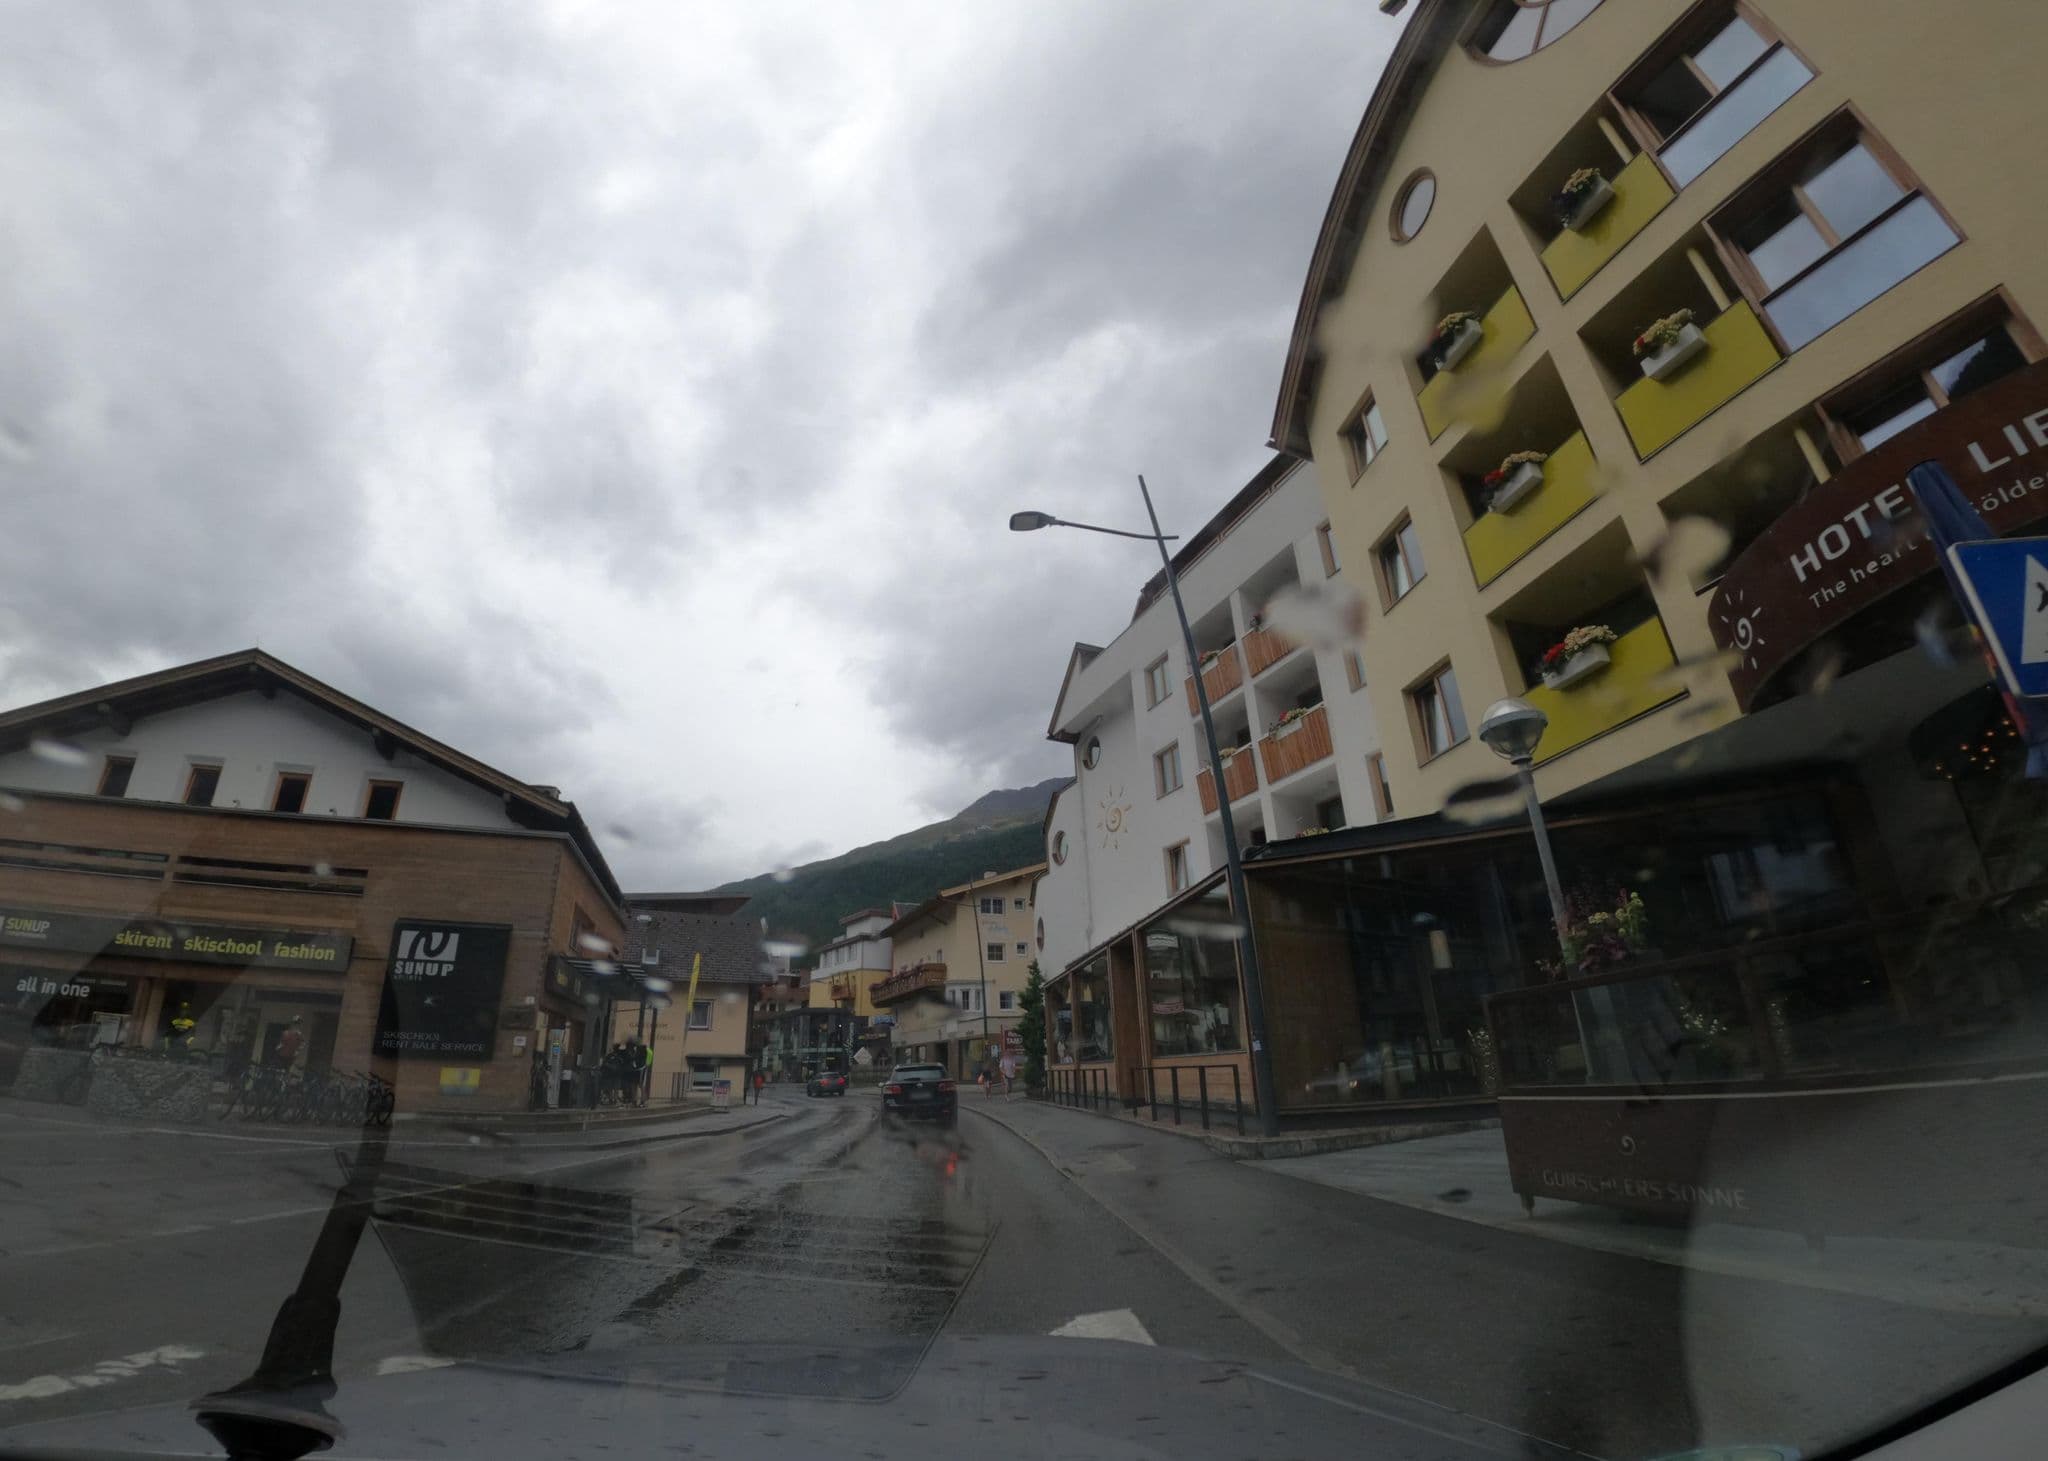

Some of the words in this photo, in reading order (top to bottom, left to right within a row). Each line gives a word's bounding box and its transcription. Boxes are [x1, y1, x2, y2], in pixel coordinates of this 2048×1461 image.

[1789, 478, 1916, 583] HOTE
[1809, 580, 1847, 608] The
[1969, 472, 2048, 514] ölde
[5, 918, 50, 932] SUNUP
[115, 930, 173, 949] skirent
[184, 936, 262, 956] skischool
[274, 942, 336, 961] fashion
[394, 960, 454, 976] SUNUP
[17, 976, 37, 992] all
[41, 977, 57, 995] in
[60, 983, 90, 997] one
[1668, 1181, 1750, 1209] SONNE
